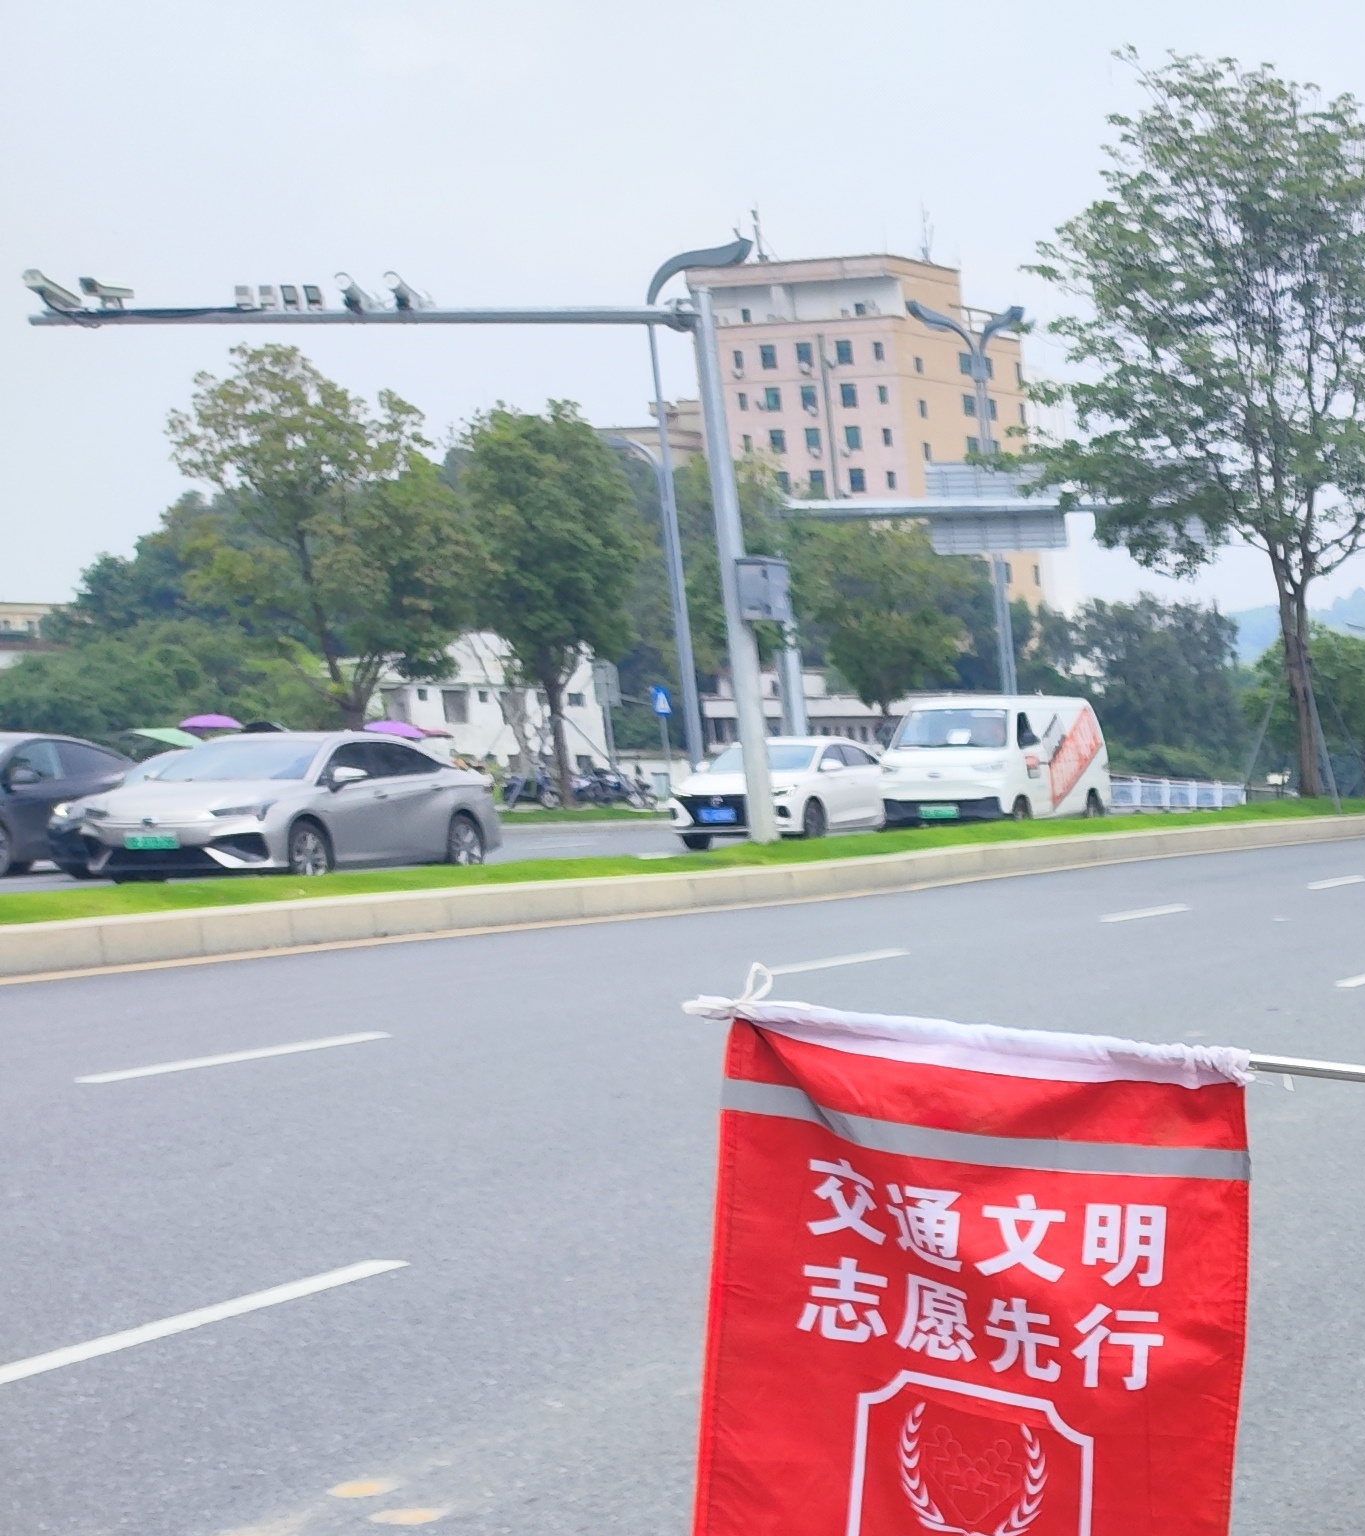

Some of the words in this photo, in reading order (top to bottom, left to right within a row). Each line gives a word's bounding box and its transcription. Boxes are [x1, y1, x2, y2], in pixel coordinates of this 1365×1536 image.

[806, 1158, 1167, 1287] 交通文明
[797, 1257, 1164, 1390] 志愿先行
